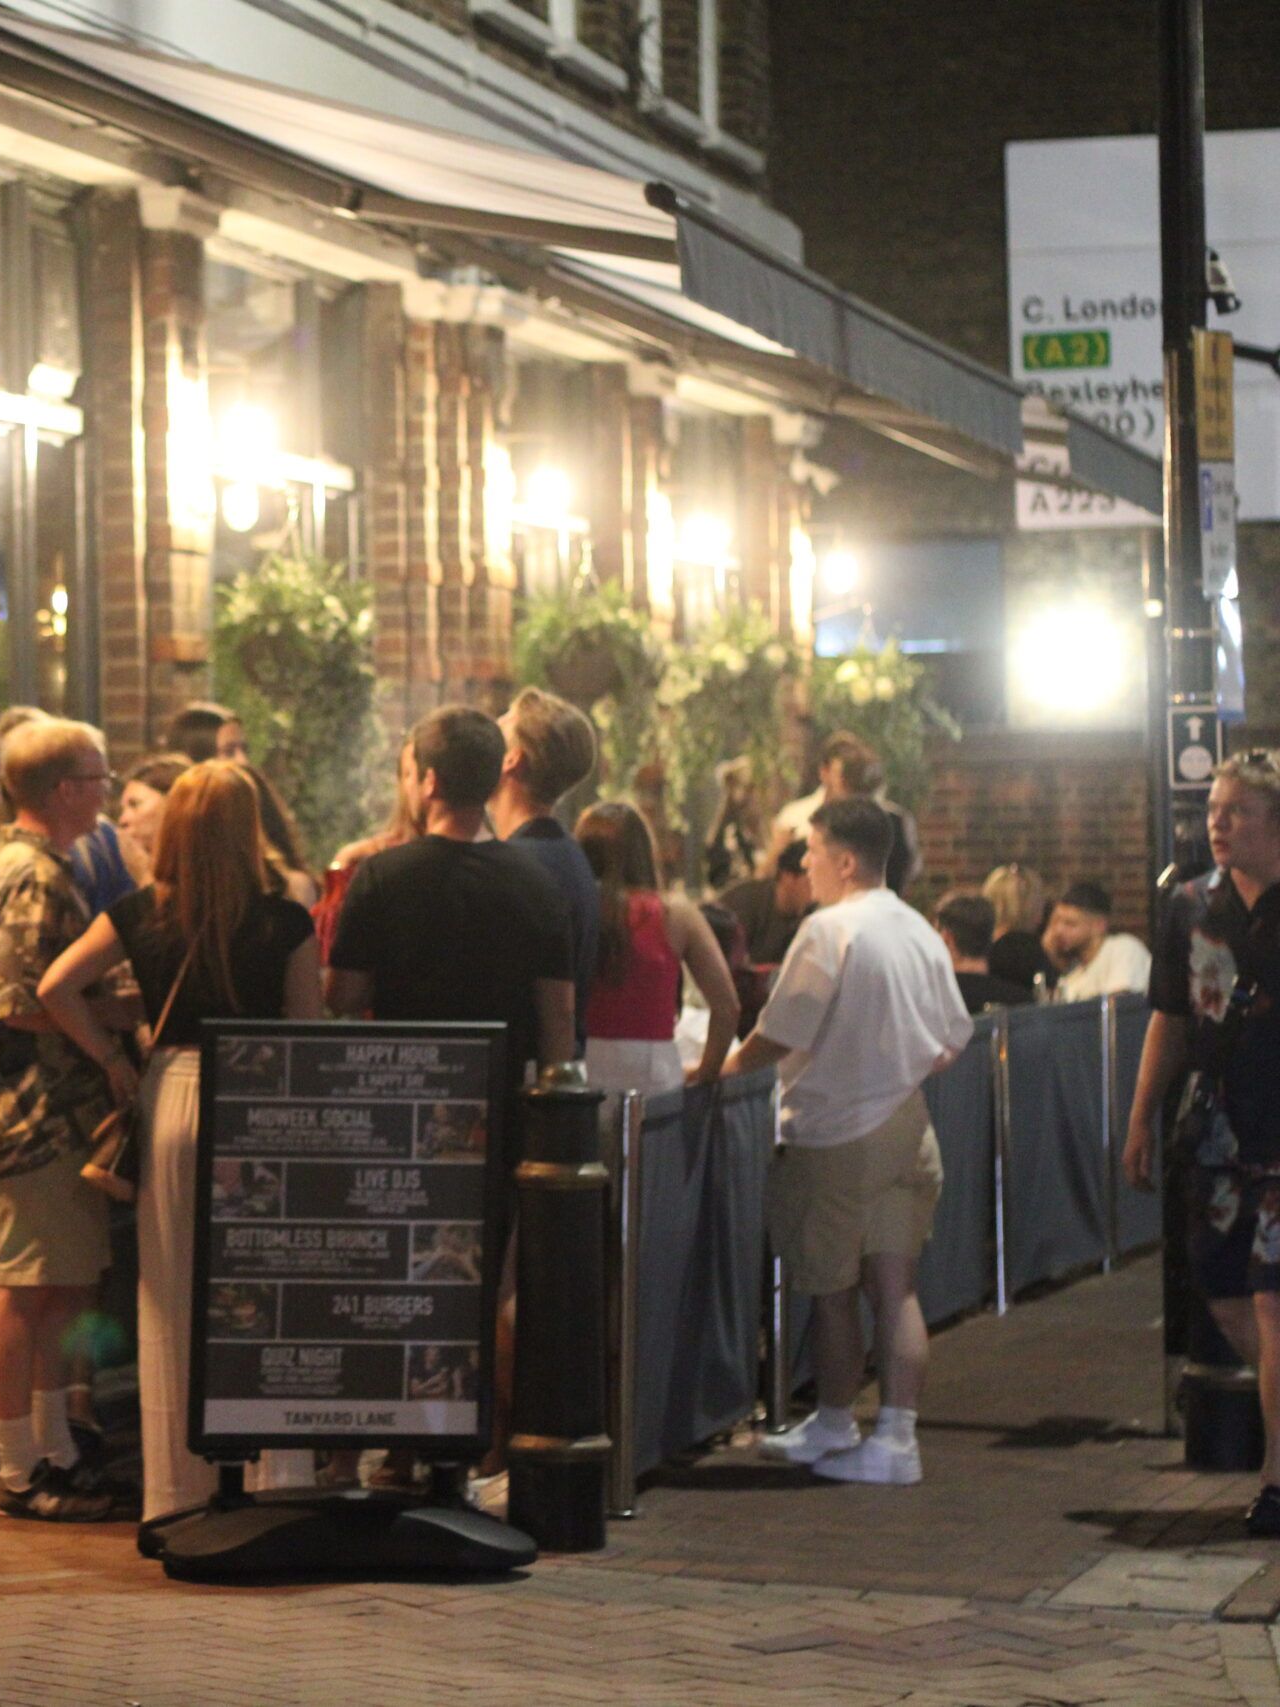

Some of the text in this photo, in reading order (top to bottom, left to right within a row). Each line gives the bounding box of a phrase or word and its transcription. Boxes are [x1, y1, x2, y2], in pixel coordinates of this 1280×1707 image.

[1063, 292, 1159, 322] Londo
[1026, 333, 1106, 367] (A2)
[346, 1045, 439, 1064] HAPPY HOUR
[247, 1108, 373, 1128] MIDWEEK SOCIAL
[355, 1168, 421, 1189] LIVE DJS
[226, 1228, 388, 1248] BOTTOMLESS BRUNCH
[332, 1294, 434, 1315] 241 BURGERS
[261, 1347, 343, 1366] QUIZ NIGHT
[284, 1411, 397, 1426] TANYARD LANE
